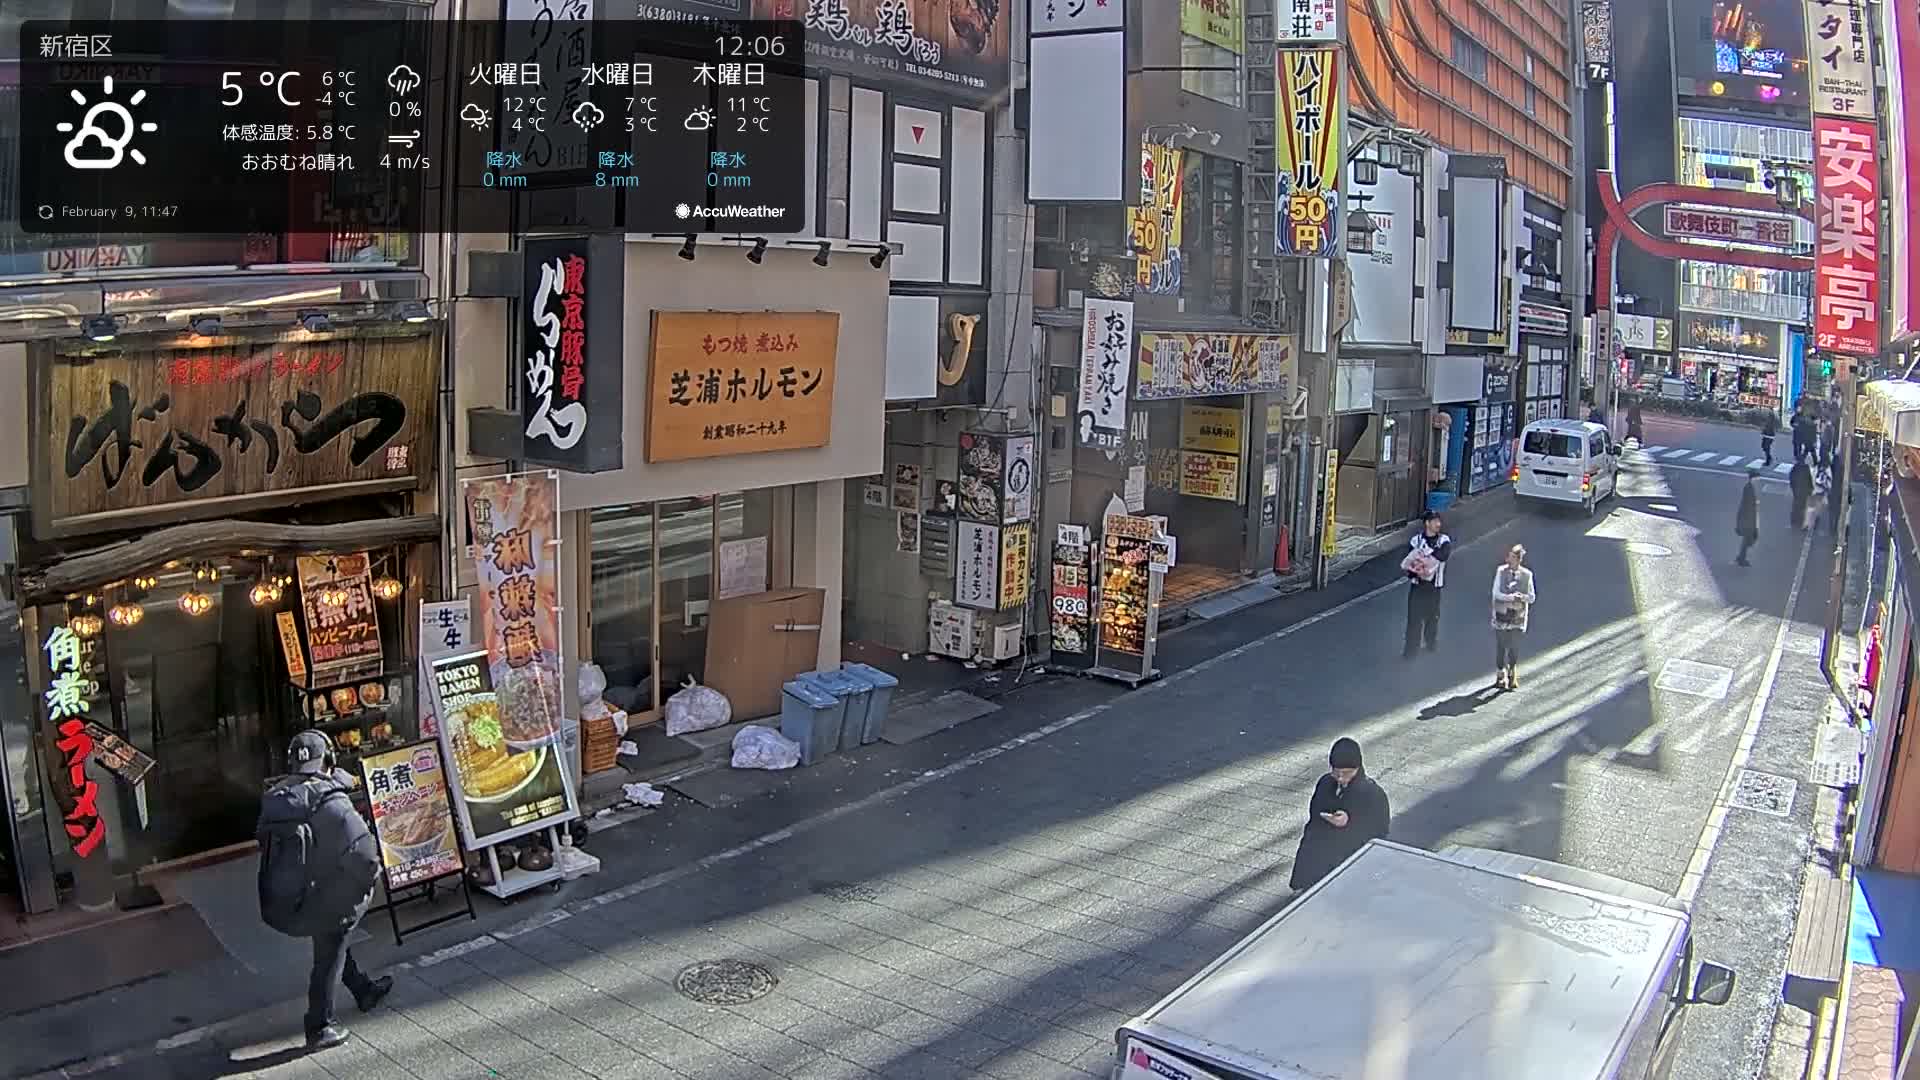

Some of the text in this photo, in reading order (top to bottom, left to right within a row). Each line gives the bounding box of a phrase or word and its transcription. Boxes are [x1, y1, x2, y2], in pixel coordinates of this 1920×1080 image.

[1590, 64, 1609, 80] 7F
[1818, 85, 1868, 97] RESTAURANT
[1832, 98, 1855, 112] 3F
[1295, 54, 1321, 191] ハイボール
[1160, 153, 1175, 288] ハイボール
[1289, 196, 1328, 222] 50
[1133, 218, 1158, 252] 50
[1295, 224, 1320, 252] 円
[1670, 211, 1793, 243] 歌舞伎町一番街
[1819, 127, 1875, 330] 安楽亭
[1135, 253, 1152, 287] 円
[561, 255, 585, 401] 東京豚骨
[1818, 333, 1836, 347] 2F
[702, 333, 800, 355] もつ焼 煮込み
[1098, 308, 1127, 415] お好み焼き
[669, 366, 823, 406] 芝浦ホルモン
[703, 420, 787, 440] 創業昭和二十九年
[1098, 433, 1122, 448] B1F
[972, 527, 987, 601] 芝浦ホルモン
[1054, 597, 1087, 614] 980
[435, 664, 480, 684] TOKYO
[439, 677, 481, 697] RAMEN
[442, 692, 472, 708] SHOP
[369, 763, 414, 796] 角煮
